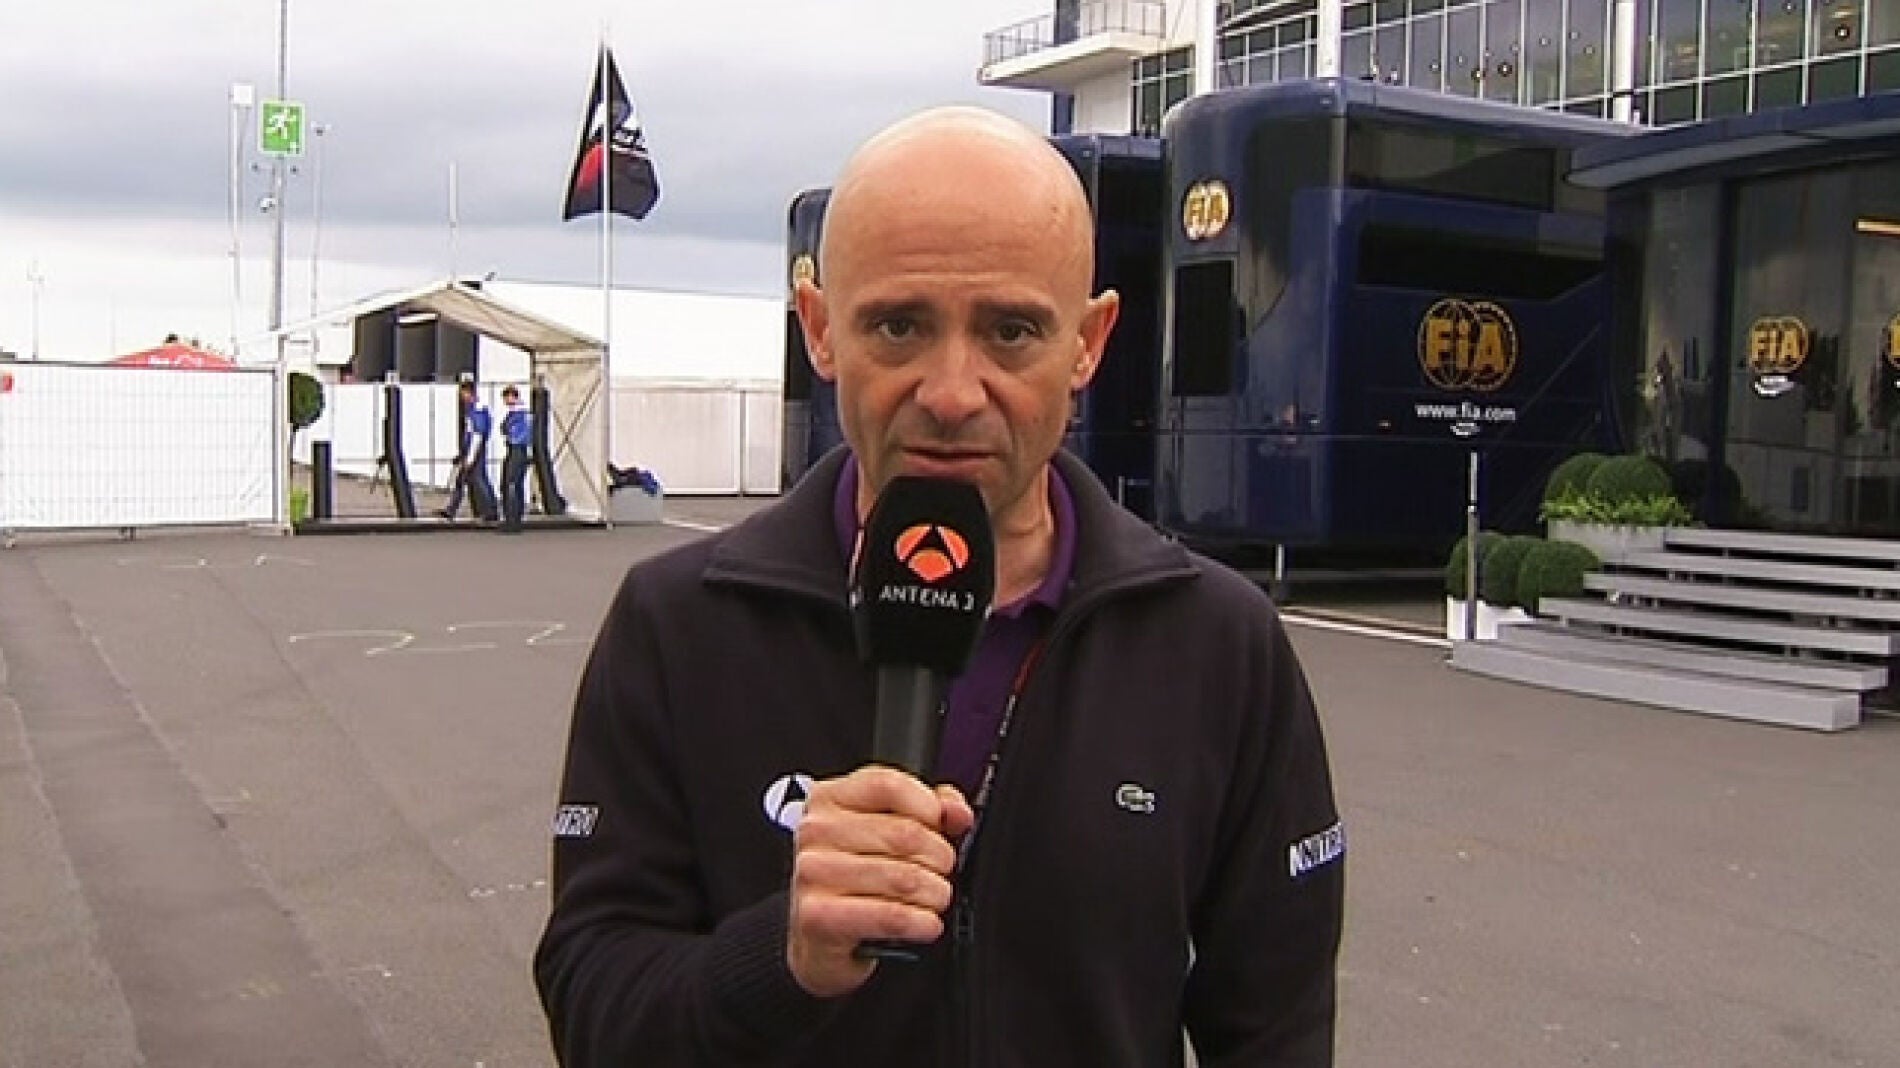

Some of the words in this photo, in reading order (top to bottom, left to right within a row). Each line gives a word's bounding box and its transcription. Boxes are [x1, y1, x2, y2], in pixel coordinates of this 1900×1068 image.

[1750, 328, 1800, 361] FIA
[1415, 401, 1517, 421] www.fia.com
[879, 585, 959, 609] ANTENA
[963, 591, 975, 610] 3
